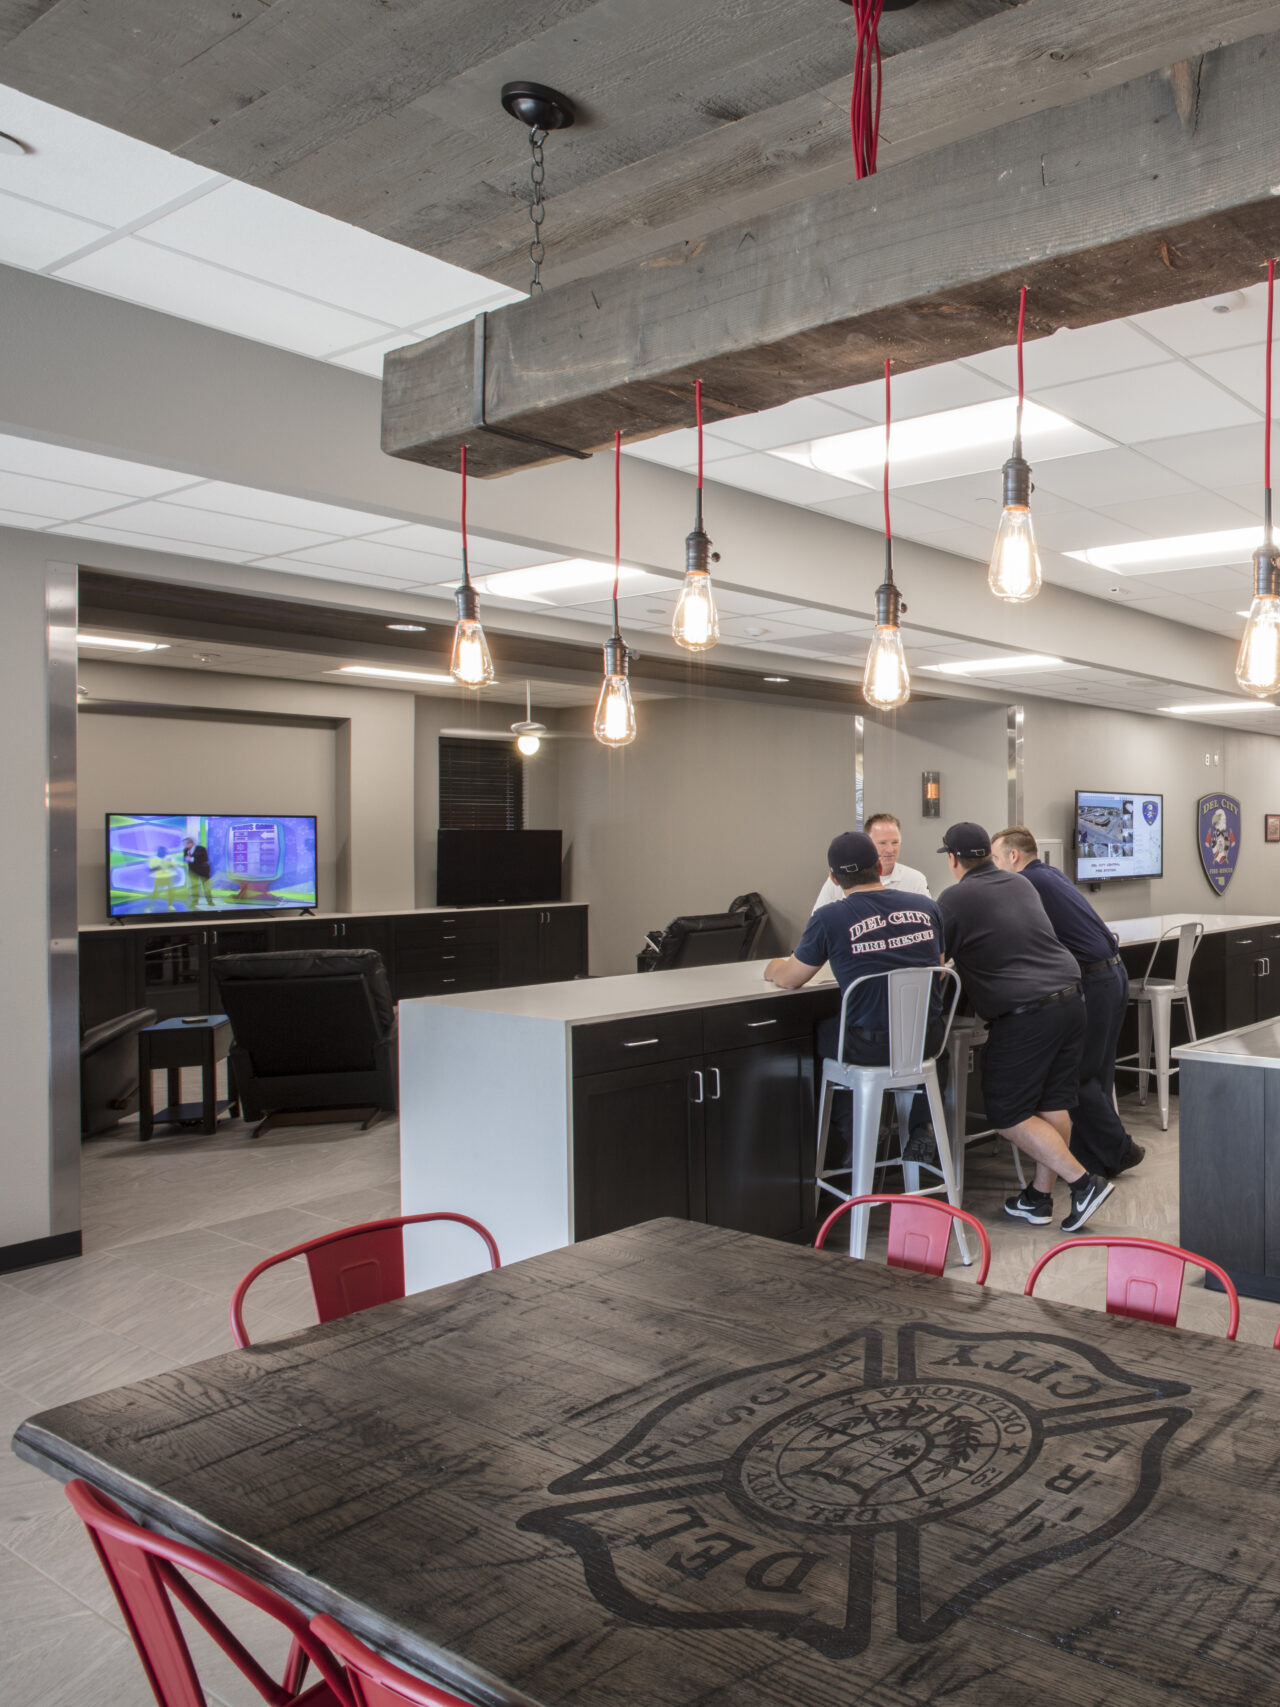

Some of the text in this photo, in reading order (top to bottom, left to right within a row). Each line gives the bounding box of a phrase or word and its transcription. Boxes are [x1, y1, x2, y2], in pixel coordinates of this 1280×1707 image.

[1203, 798, 1239, 816] DEL CITY
[849, 910, 932, 941] DEL CITY
[852, 929, 935, 954] FIRE RESCUE
[929, 1344, 1102, 1400] CITY
[624, 1352, 862, 1470] RESCUE
[876, 1385, 1028, 1435] OKLAHOMA
[746, 1470, 881, 1523] DEL CITY
[951, 1435, 1130, 1567] FIRE
[631, 1504, 829, 1595] DEL
